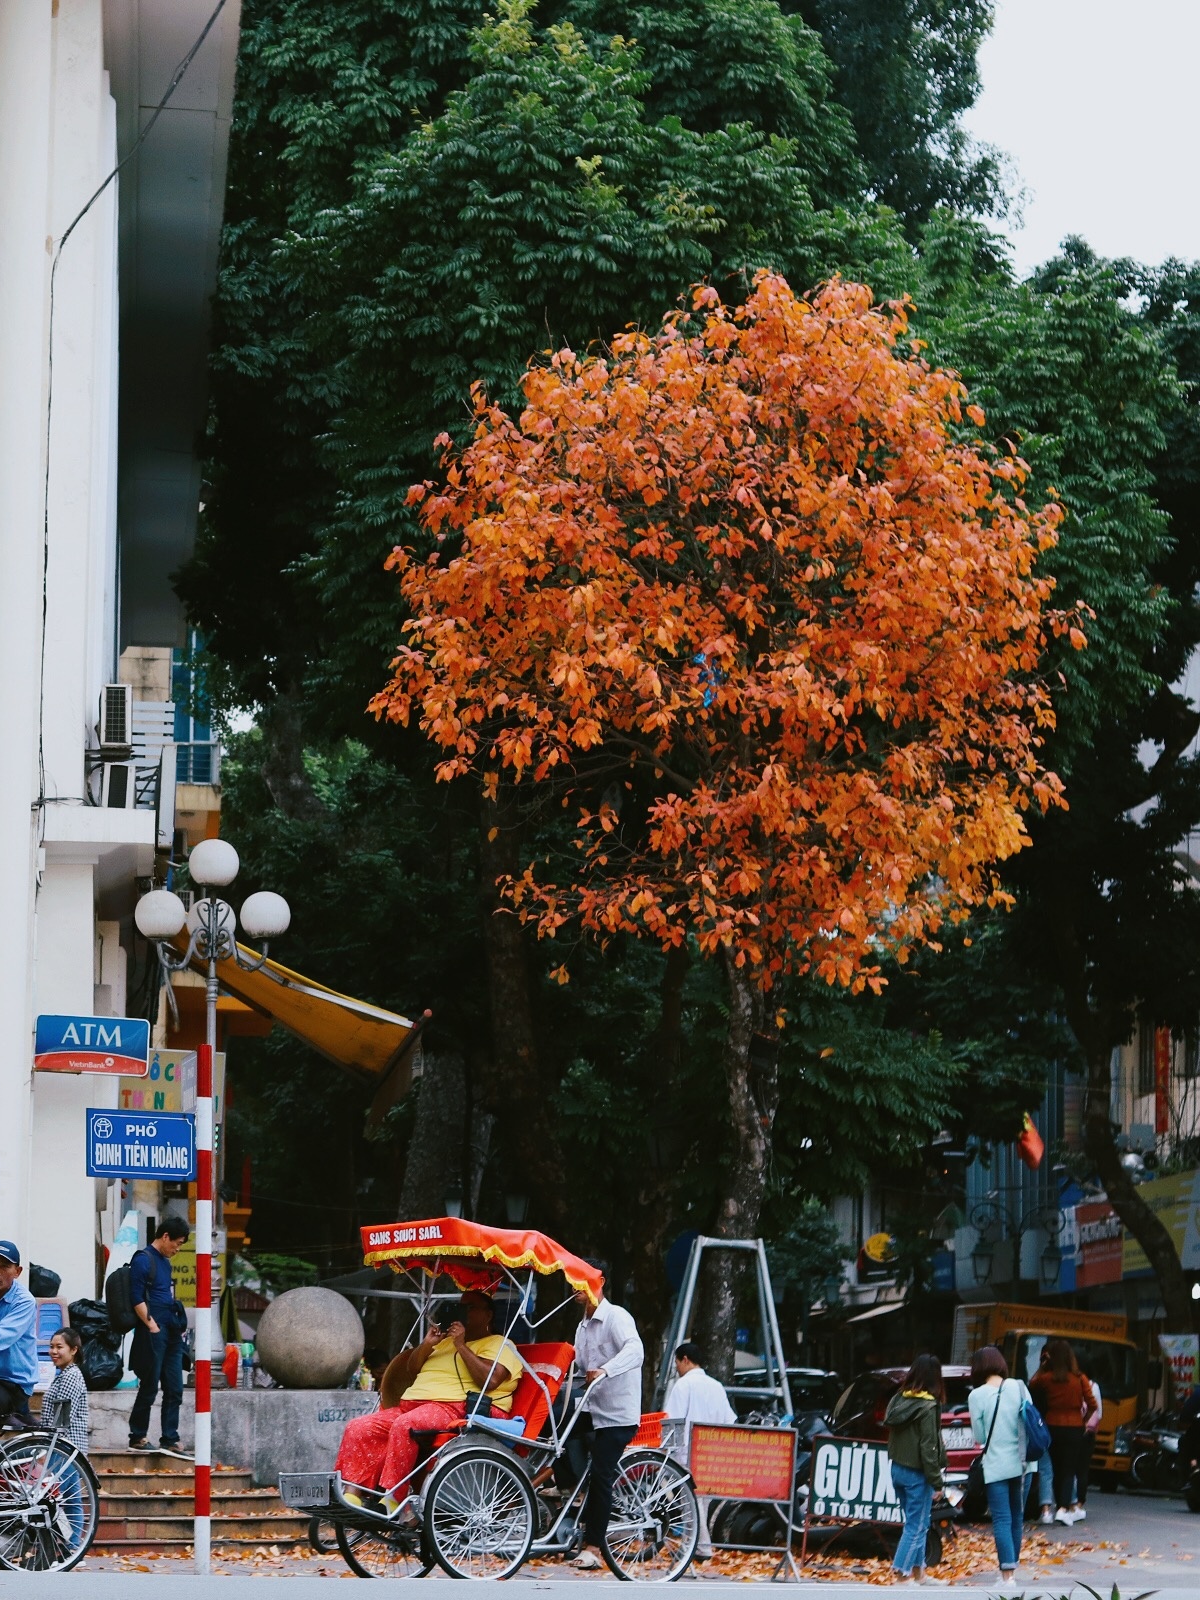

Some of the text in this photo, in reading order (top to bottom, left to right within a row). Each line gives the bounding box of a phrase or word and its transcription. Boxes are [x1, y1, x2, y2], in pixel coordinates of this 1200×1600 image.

[61, 1022, 122, 1048] ATM
[69, 1060, 106, 1069] VietinBank
[125, 1121, 158, 1137] PHỐ
[95, 1139, 189, 1170] ĐINH TIÊN HOÀNG
[369, 1225, 443, 1246] SANS SOUCI SARL
[814, 1441, 877, 1502] GỬI
[814, 1498, 826, 1516] Ô
